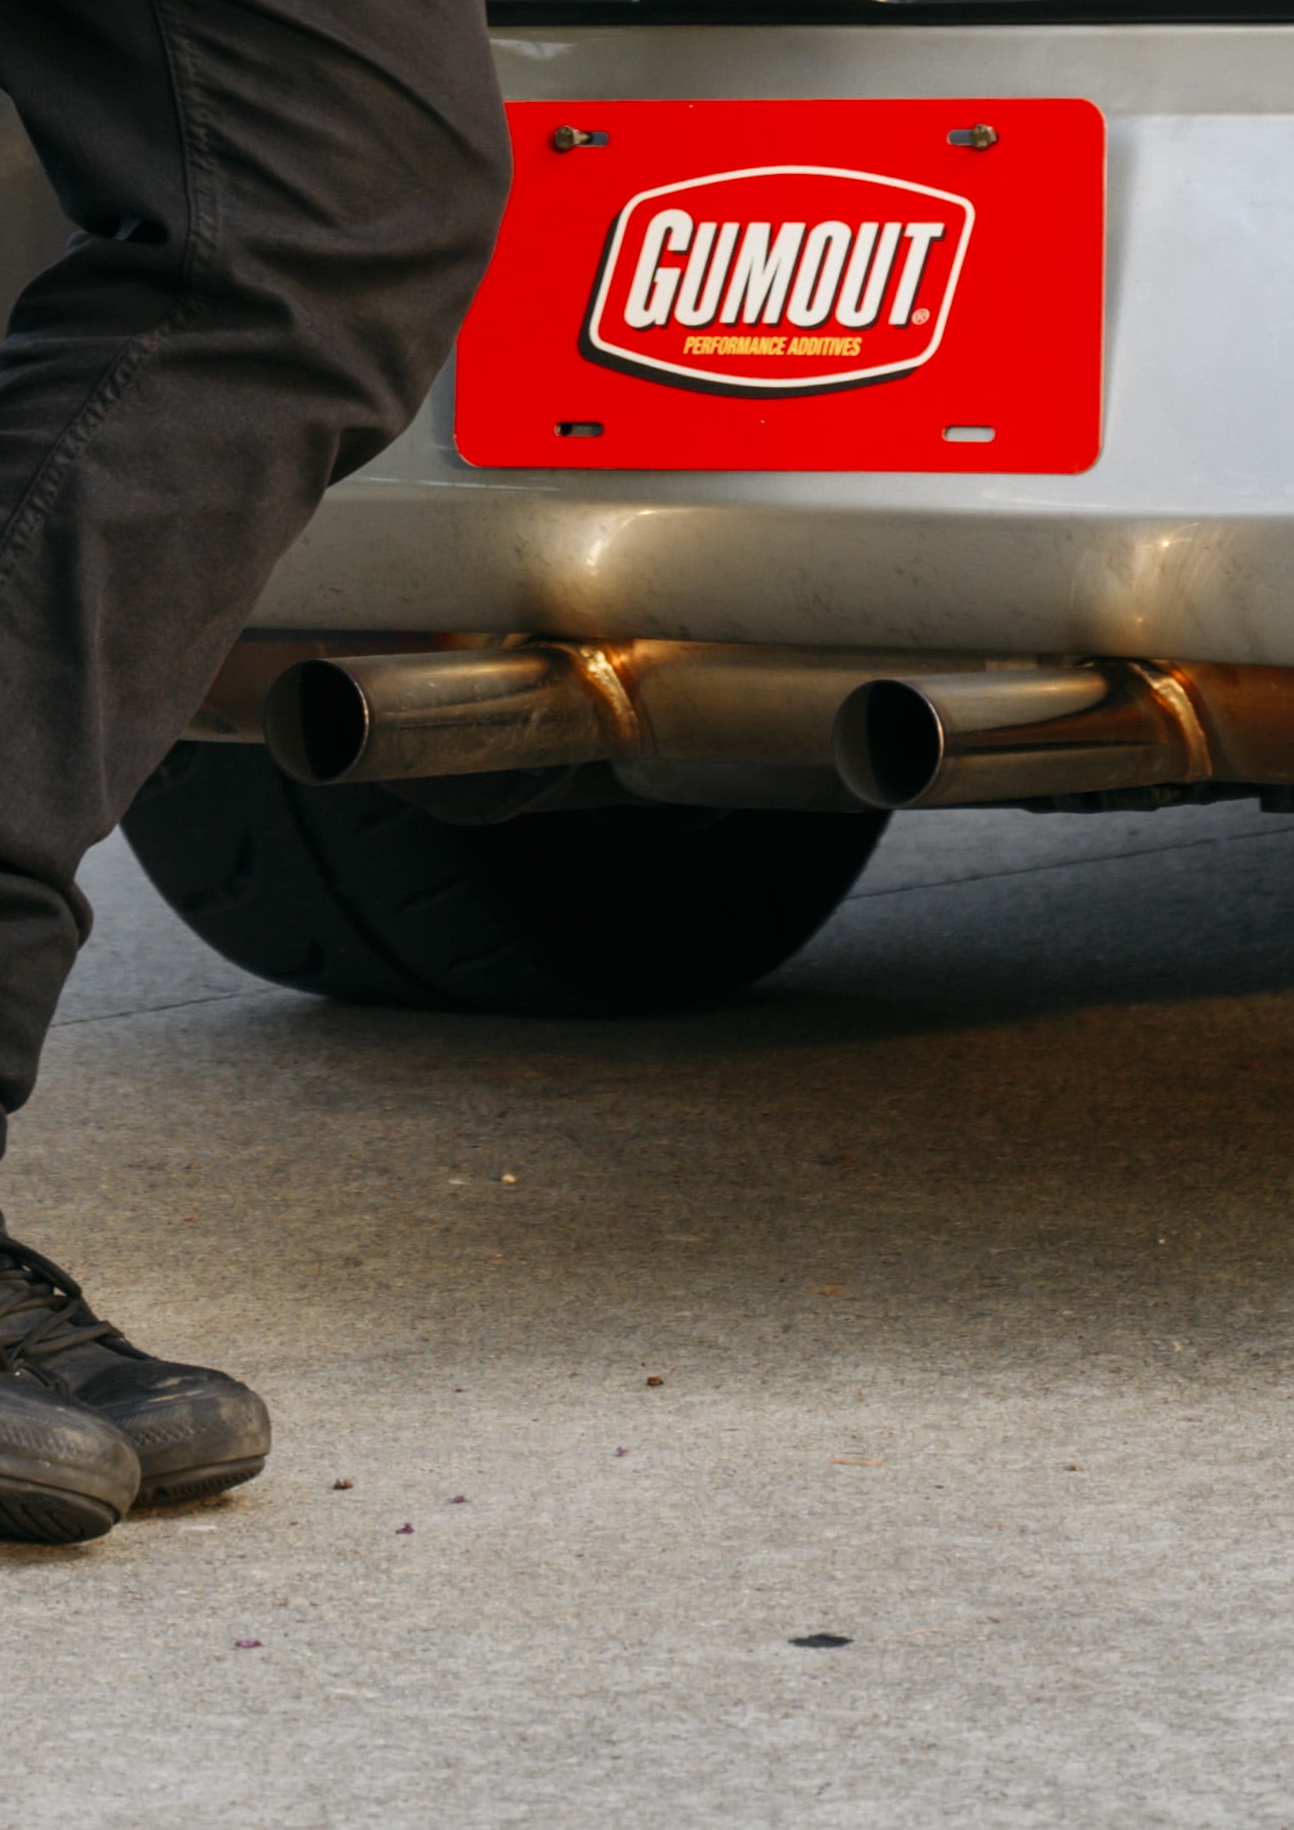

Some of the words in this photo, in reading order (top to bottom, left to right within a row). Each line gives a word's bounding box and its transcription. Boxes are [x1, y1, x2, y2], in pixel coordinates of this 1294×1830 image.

[623, 208, 944, 329] GUMOUT
[683, 336, 787, 356] PERFORMANCE
[787, 336, 863, 357] ADDITIVES
